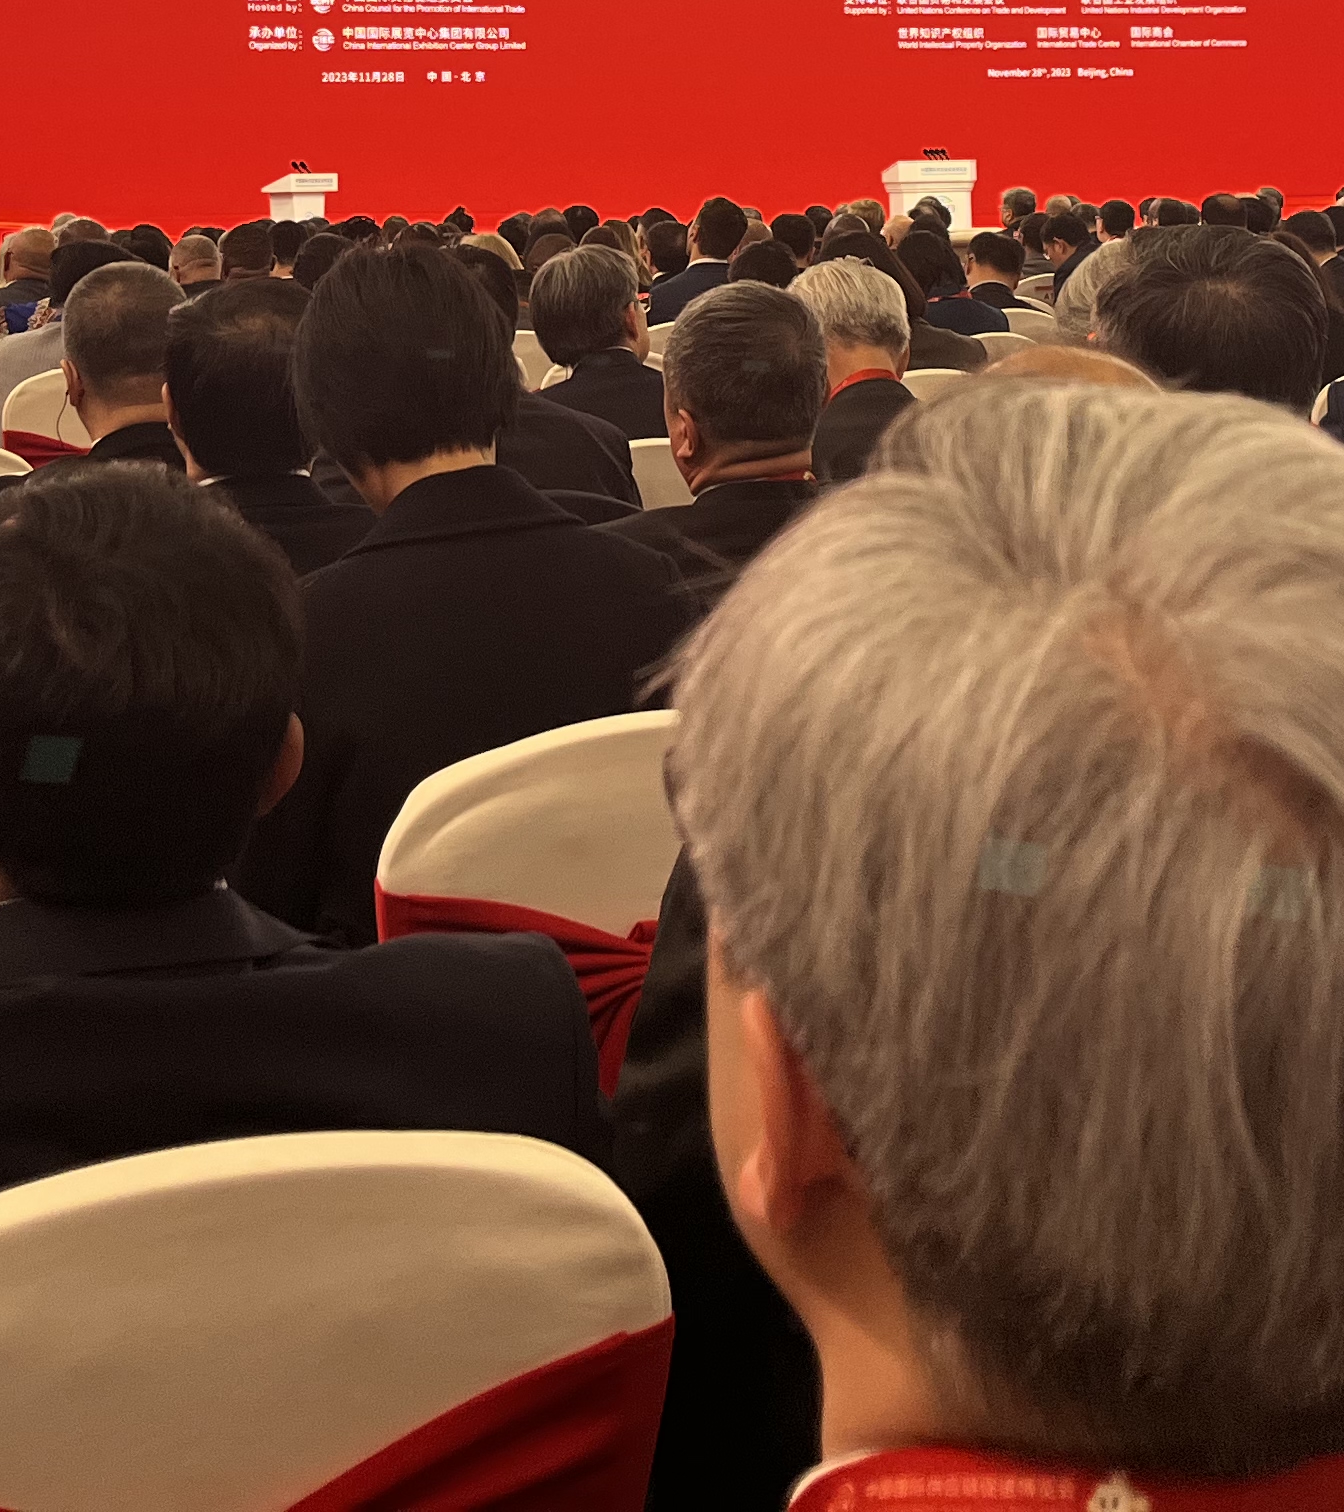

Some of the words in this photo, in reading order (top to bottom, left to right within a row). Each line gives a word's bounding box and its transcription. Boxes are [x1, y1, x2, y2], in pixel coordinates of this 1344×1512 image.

[247, 3, 283, 12] Hosted
[342, 26, 510, 40] 中国国际展览中心集团有限公司
[898, 27, 985, 40] 世界知识产权组织
[1037, 26, 1102, 39] 国际贸易中心
[321, 71, 405, 83] 2023年11月28日
[987, 67, 1030, 78] November
[1050, 67, 1072, 78] 2023
[1109, 67, 1134, 77] China
